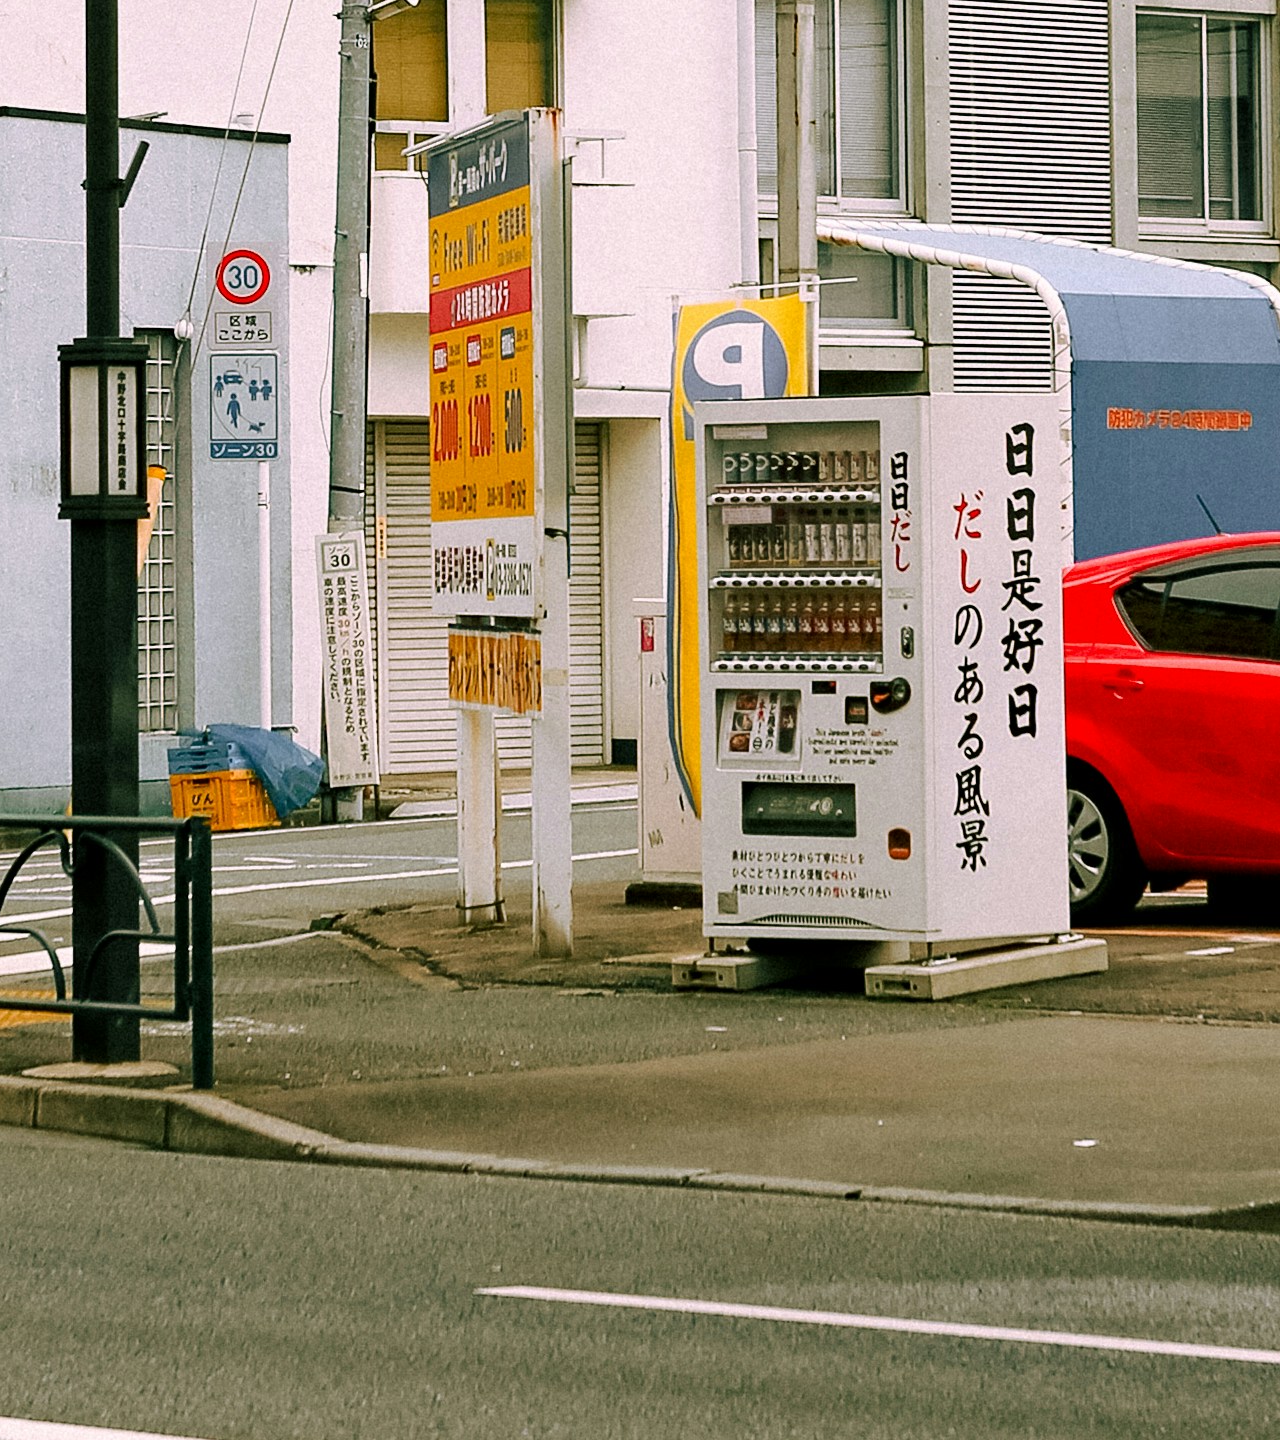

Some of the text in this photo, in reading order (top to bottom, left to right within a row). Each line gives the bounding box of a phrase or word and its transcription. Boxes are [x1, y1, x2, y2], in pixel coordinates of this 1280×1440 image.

[443, 232, 463, 274] Free
[466, 217, 491, 267] Wi-Fi
[228, 265, 259, 290] 30
[229, 315, 258, 327] 区域
[219, 329, 269, 342] ここから
[213, 444, 275, 458] ゾーン30
[890, 451, 912, 572] 日日だし
[329, 546, 350, 555] ゾーン
[330, 554, 351, 568] 30
[1001, 422, 1044, 739] 日日是好日
[952, 490, 990, 872] だしのある風景
[191, 793, 214, 806] びん
